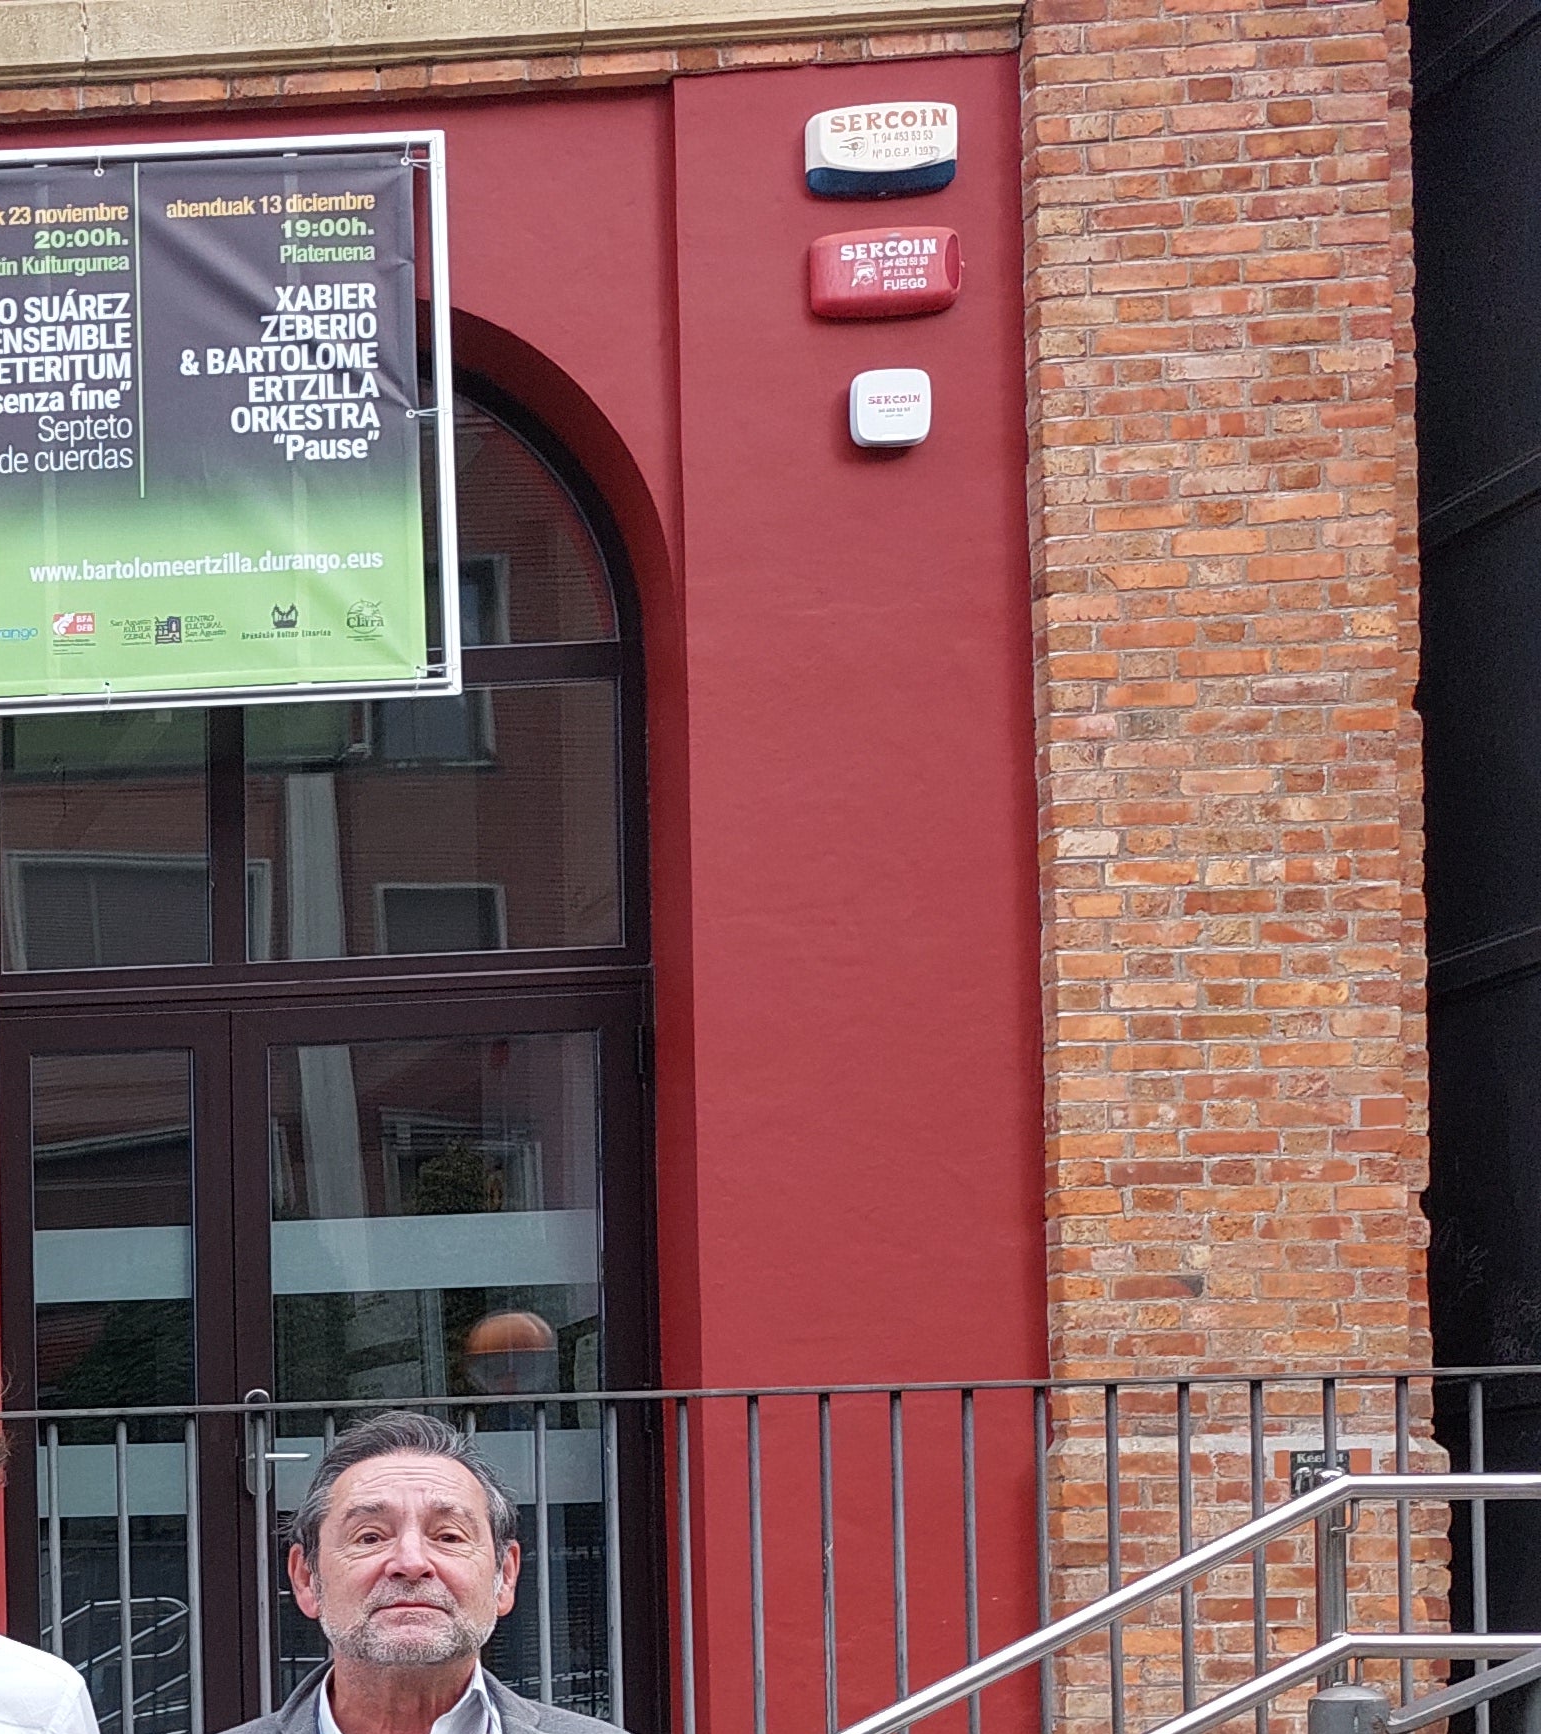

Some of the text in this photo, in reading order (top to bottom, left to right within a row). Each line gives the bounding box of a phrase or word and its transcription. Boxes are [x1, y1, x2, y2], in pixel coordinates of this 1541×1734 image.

[9, 206, 31, 224] 23
[35, 202, 129, 222] noviembre
[166, 192, 375, 219] abenduak 13 diciembre
[35, 229, 129, 248] 20:00h.
[281, 218, 375, 238] 19:00h.
[22, 251, 129, 276] Kulturgunea
[280, 242, 375, 265] Plateruena
[841, 239, 937, 260] SERCOIN
[276, 282, 376, 312] XABIER
[884, 277, 927, 290] FUEGO
[23, 289, 130, 324] SUÁREZ
[260, 312, 377, 344] ZEBERIO
[180, 342, 378, 376] & BARTOLOME
[249, 372, 380, 404] ERTZILLA
[38, 414, 133, 444] Septeto
[231, 402, 380, 436] ORKESTRA
[35, 442, 133, 471] cuerdas
[29, 549, 383, 584] www.bartolomeertzilla.durango.eus
